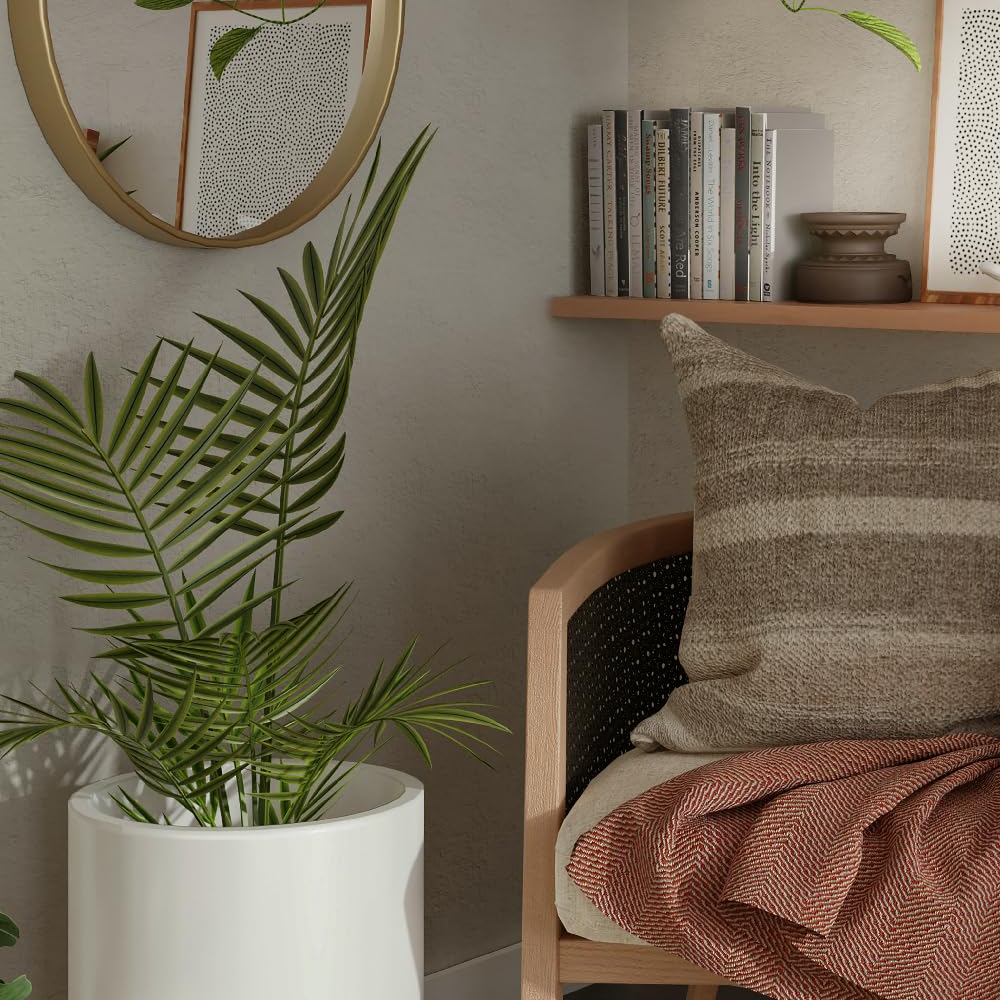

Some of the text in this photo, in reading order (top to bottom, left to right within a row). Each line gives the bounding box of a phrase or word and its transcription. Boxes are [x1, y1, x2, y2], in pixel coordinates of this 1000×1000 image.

[658, 180, 666, 212] FUTURE
[708, 179, 716, 195] The
[750, 161, 761, 247] Into the Light
[675, 255, 686, 278] Red
